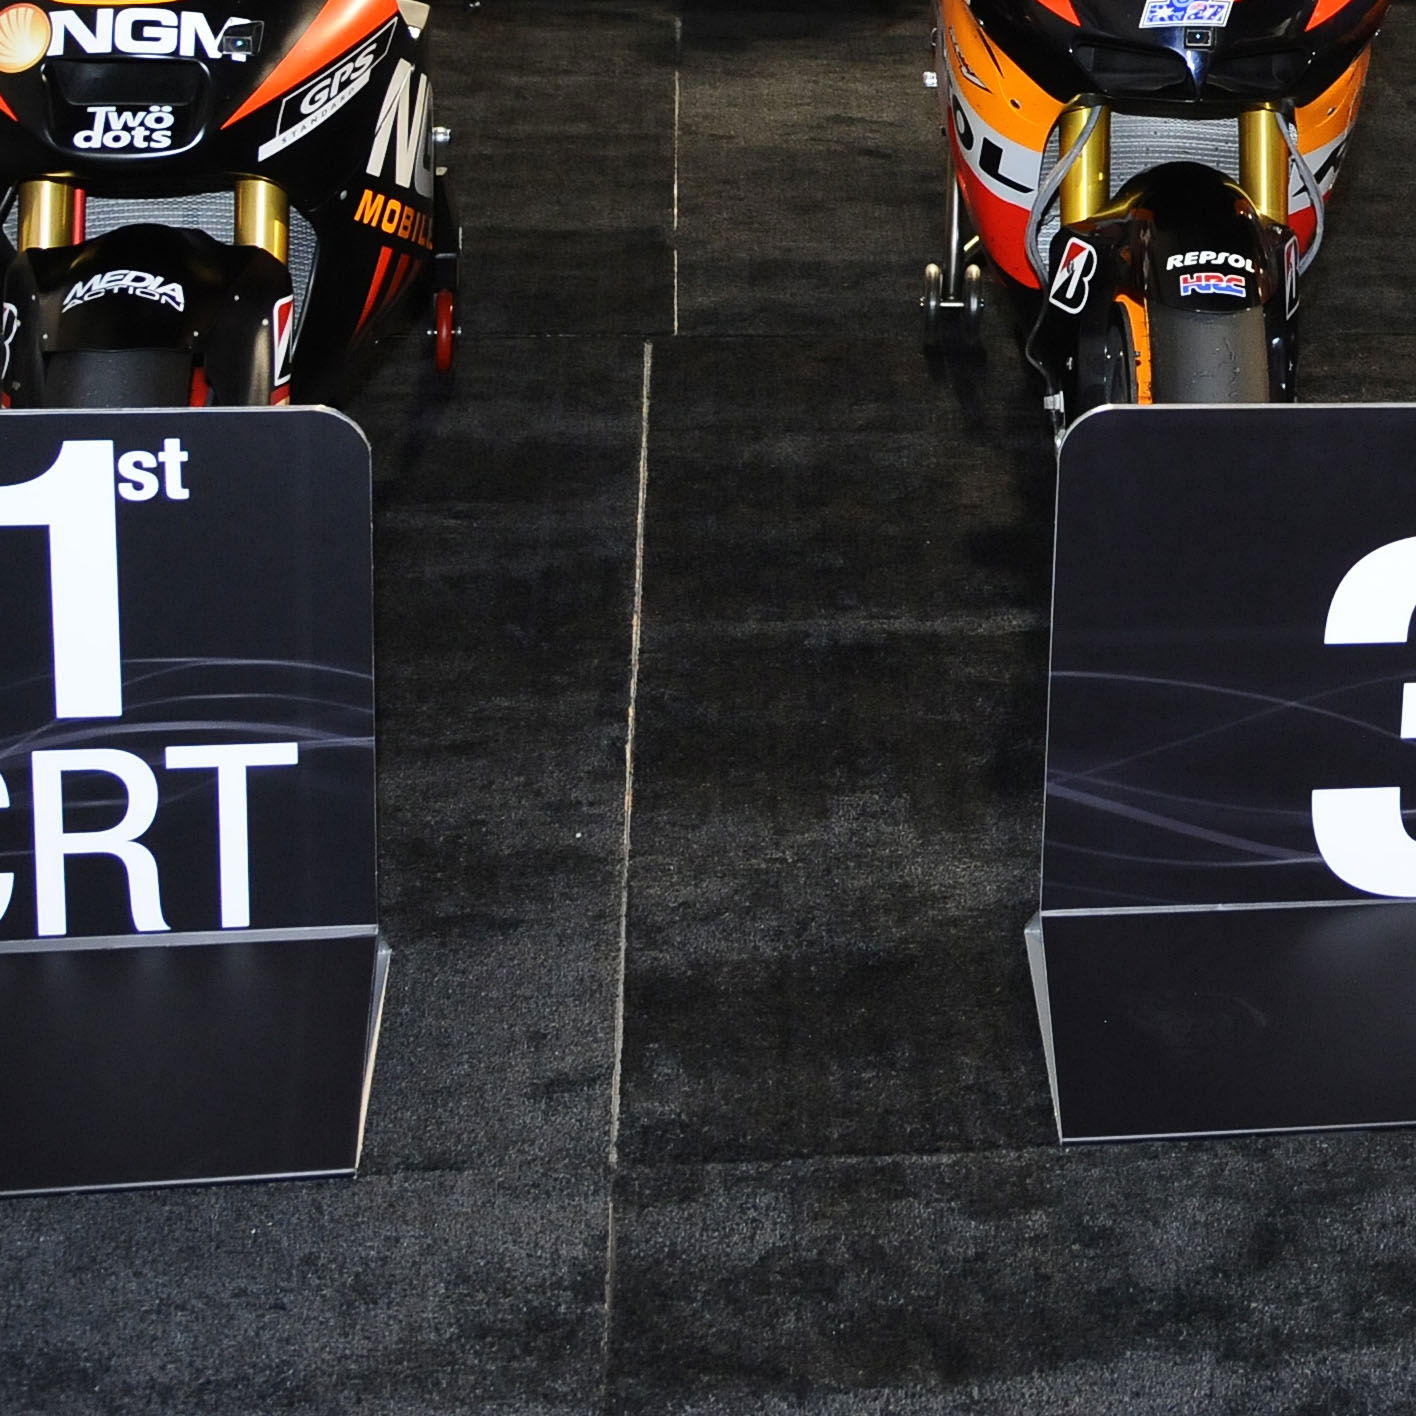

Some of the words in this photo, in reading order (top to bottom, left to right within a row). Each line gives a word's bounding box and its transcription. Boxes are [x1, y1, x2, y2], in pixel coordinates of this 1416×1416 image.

[49, 7, 252, 62] NGM
[300, 42, 377, 116] GPS
[73, 127, 172, 149] dots
[1166, 250, 1256, 273] REPSOL
[62, 269, 184, 305] MEDIA
[1180, 272, 1246, 297] HRC
[0, 742, 299, 937] RT
